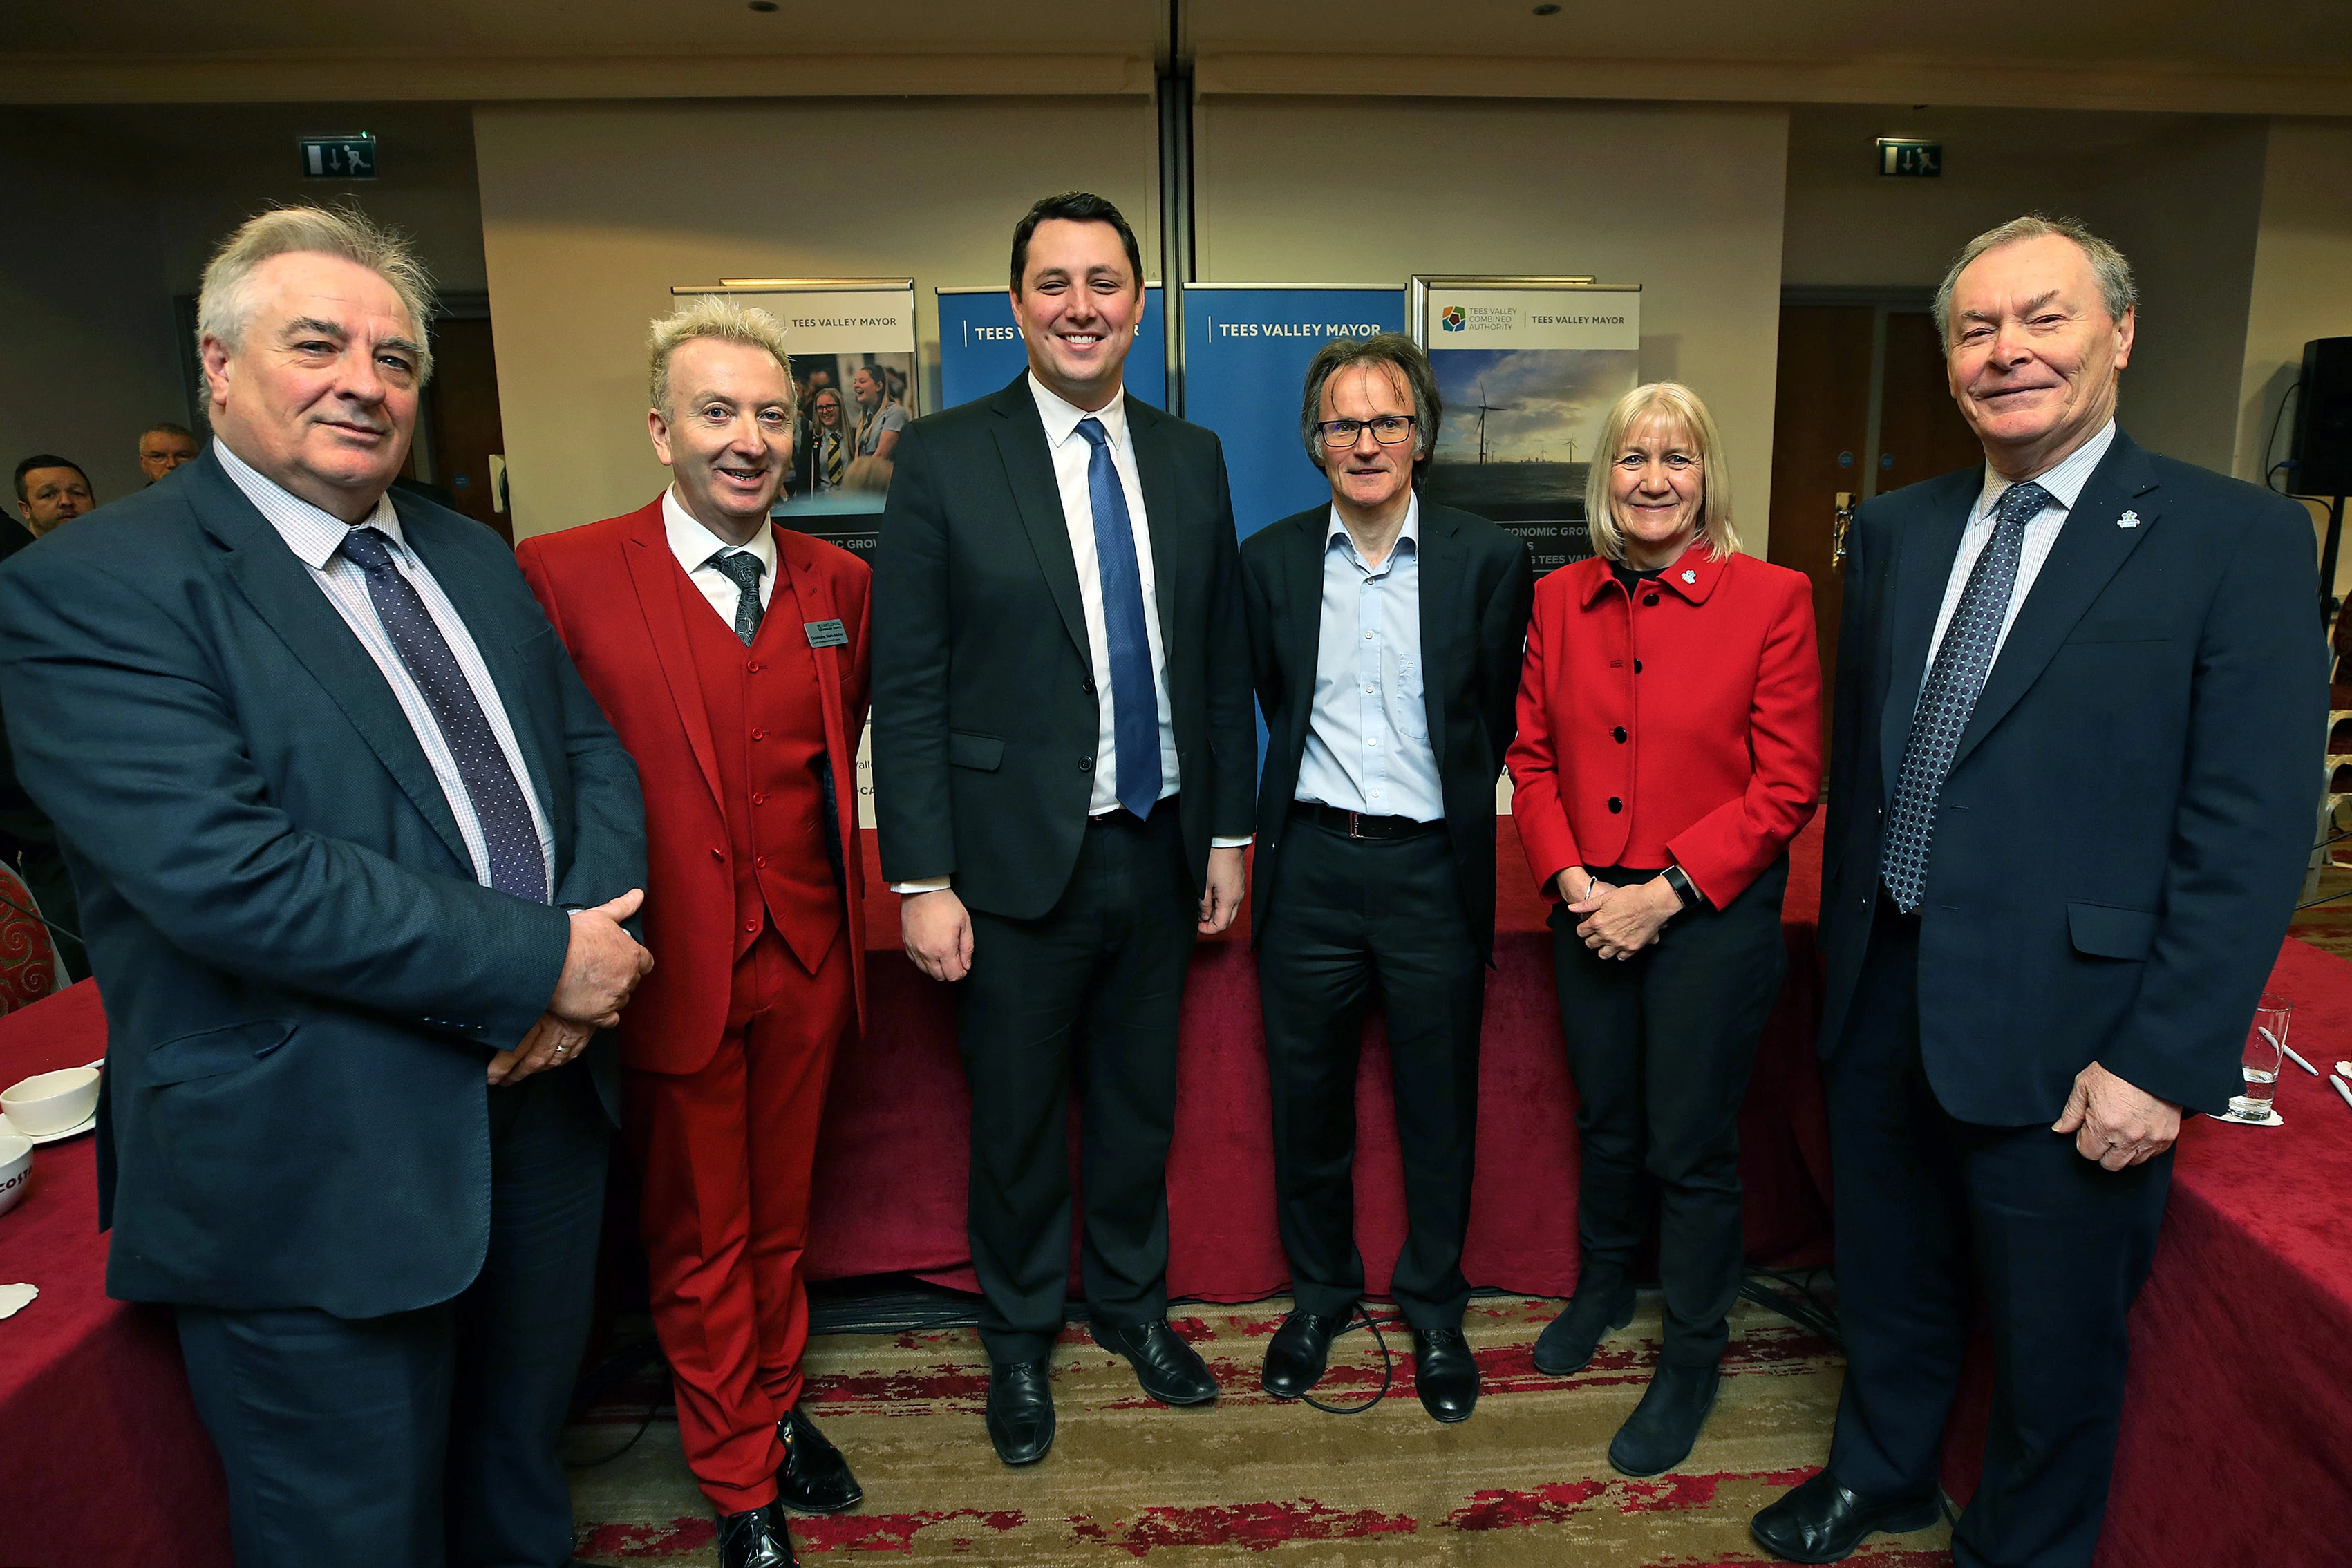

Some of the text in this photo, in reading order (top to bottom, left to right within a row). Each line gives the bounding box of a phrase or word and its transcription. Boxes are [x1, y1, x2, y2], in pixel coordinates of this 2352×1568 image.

[792, 317, 896, 328] TEES VALLEY MAYOR
[1592, 316, 1624, 324] MAYOR
[975, 327, 1013, 340] TEES
[1219, 323, 1381, 337] TEES VALLEY MAYOR
[847, 538, 877, 549] GRO
[1539, 554, 1566, 565] TEES
